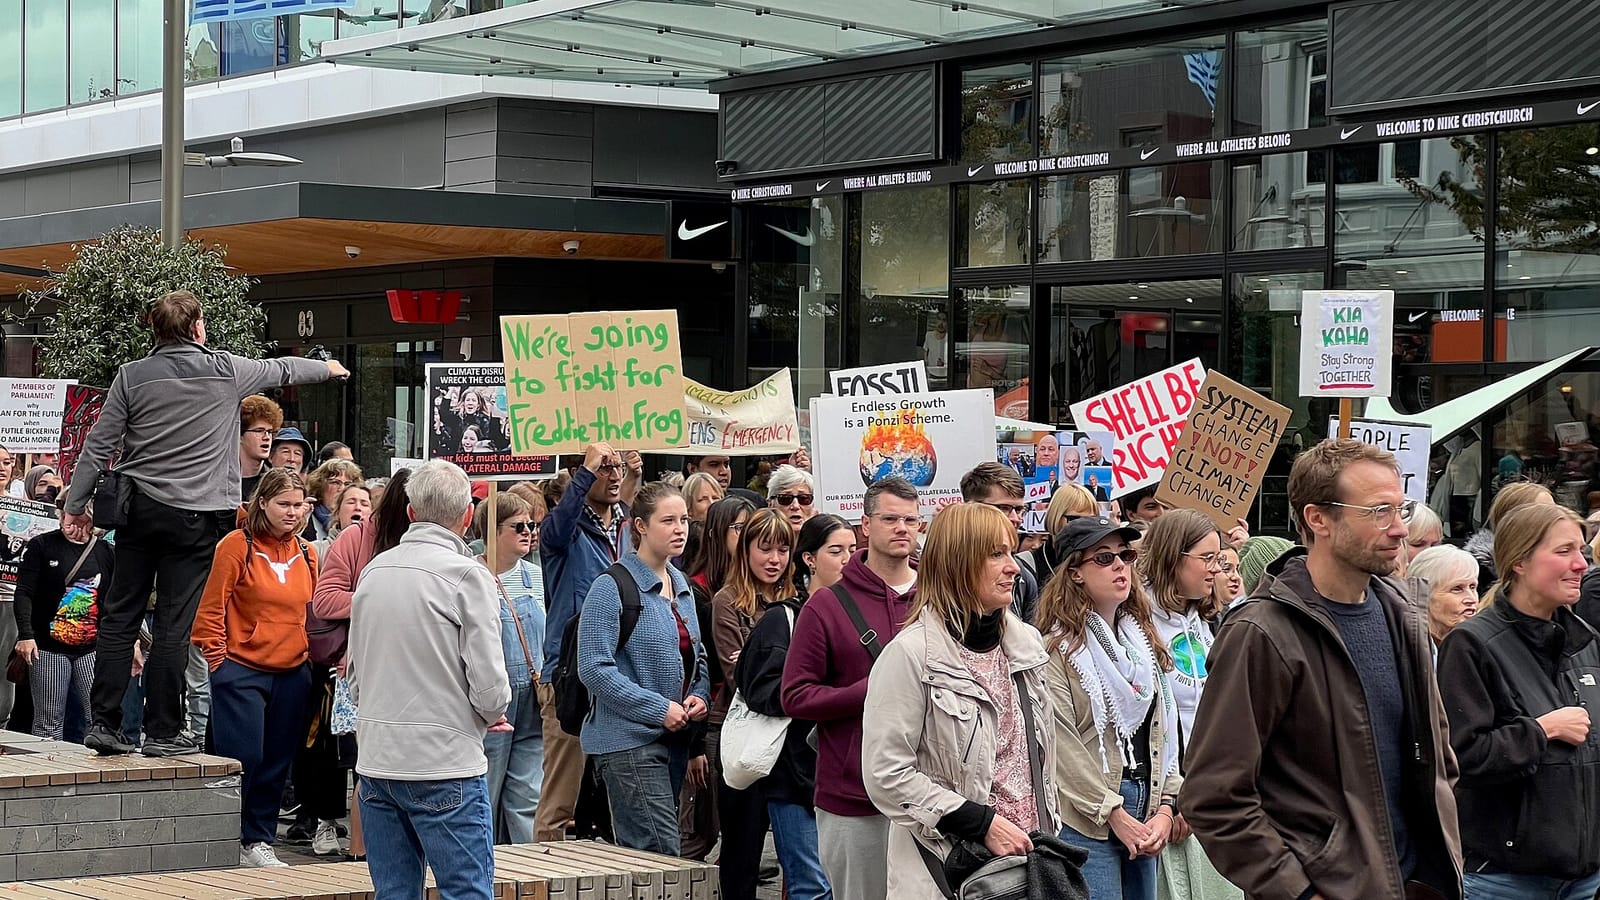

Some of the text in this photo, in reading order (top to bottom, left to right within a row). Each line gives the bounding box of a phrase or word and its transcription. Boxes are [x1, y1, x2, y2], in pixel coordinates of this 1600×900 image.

[1376, 107, 1533, 137] WELCOME TO NIKE CHRISTCHURCH
[1176, 133, 1291, 157] WHERE ALL ATHLETES BELONG
[994, 152, 1109, 175] WELCOME TO NIKE CHRISTCHURCH
[843, 170, 931, 190] WHERE ALL ATHLETES BELONG
[737, 188, 751, 200] NIKE
[751, 184, 792, 199] CHRISTCHURCH
[298, 310, 314, 337] 83
[1333, 306, 1362, 324] KIA
[1440, 310, 1480, 321] WELCOME
[504, 317, 668, 361] We're going
[1321, 326, 1369, 348] KAHA
[1321, 352, 1375, 370] Stay Strong
[440, 375, 506, 384] WRECK THE GLOB
[448, 367, 480, 376] CLIMATE
[510, 357, 675, 397] to fight for
[1319, 370, 1371, 384] TOGETHER
[11, 383, 46, 391] MEMBERS
[11, 392, 55, 400] PARLIAMENT:
[27, 402, 40, 410] why
[851, 397, 946, 413] Endless Growth
[1085, 363, 1200, 441] SHE'LL BE
[844, 412, 954, 429] is a Ponzi Scheme.
[1202, 386, 1278, 444] SYSTEM
[688, 420, 793, 449] EN'S EMERGENCY
[1192, 412, 1269, 459] CHANGE
[1337, 425, 1411, 451] EOPLE
[455, 454, 474, 463] kids
[476, 454, 497, 462] must
[1112, 420, 1187, 489] RIGH
[460, 462, 542, 473] LATERAL DAMAGE
[1176, 449, 1252, 501] CLIMATE
[840, 493, 854, 501] KIDS
[917, 488, 951, 496] OLLATERAL
[1030, 485, 1046, 497] ON
[1169, 471, 1235, 516] CHANGE
[928, 497, 937, 506] IS
